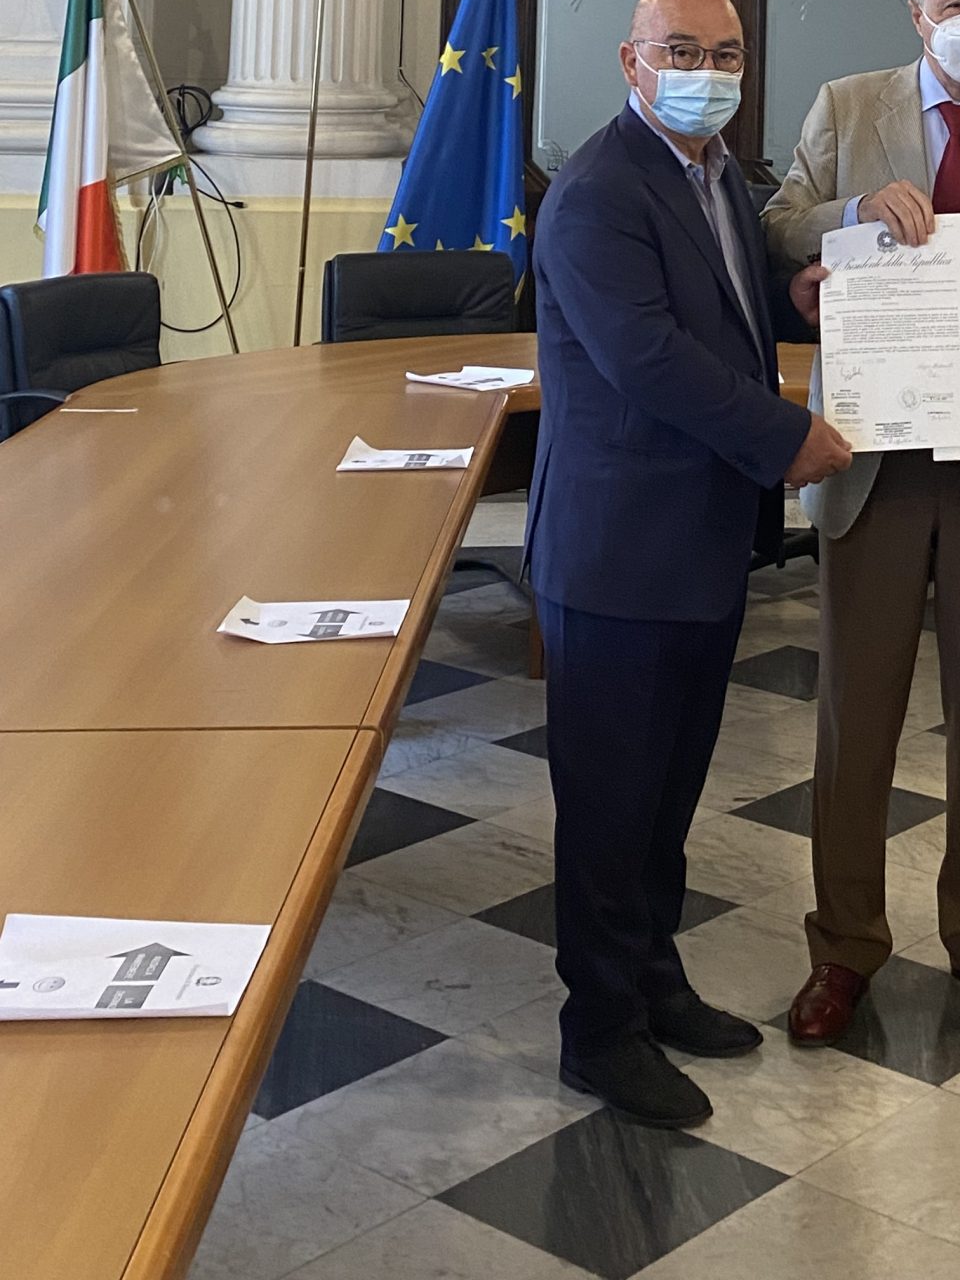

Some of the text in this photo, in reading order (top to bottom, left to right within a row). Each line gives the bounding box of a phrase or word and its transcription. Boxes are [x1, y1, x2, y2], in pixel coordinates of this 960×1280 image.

[843, 255, 883, 271] Presidente
[881, 254, 904, 267] della
[908, 252, 952, 272] Repubblica
